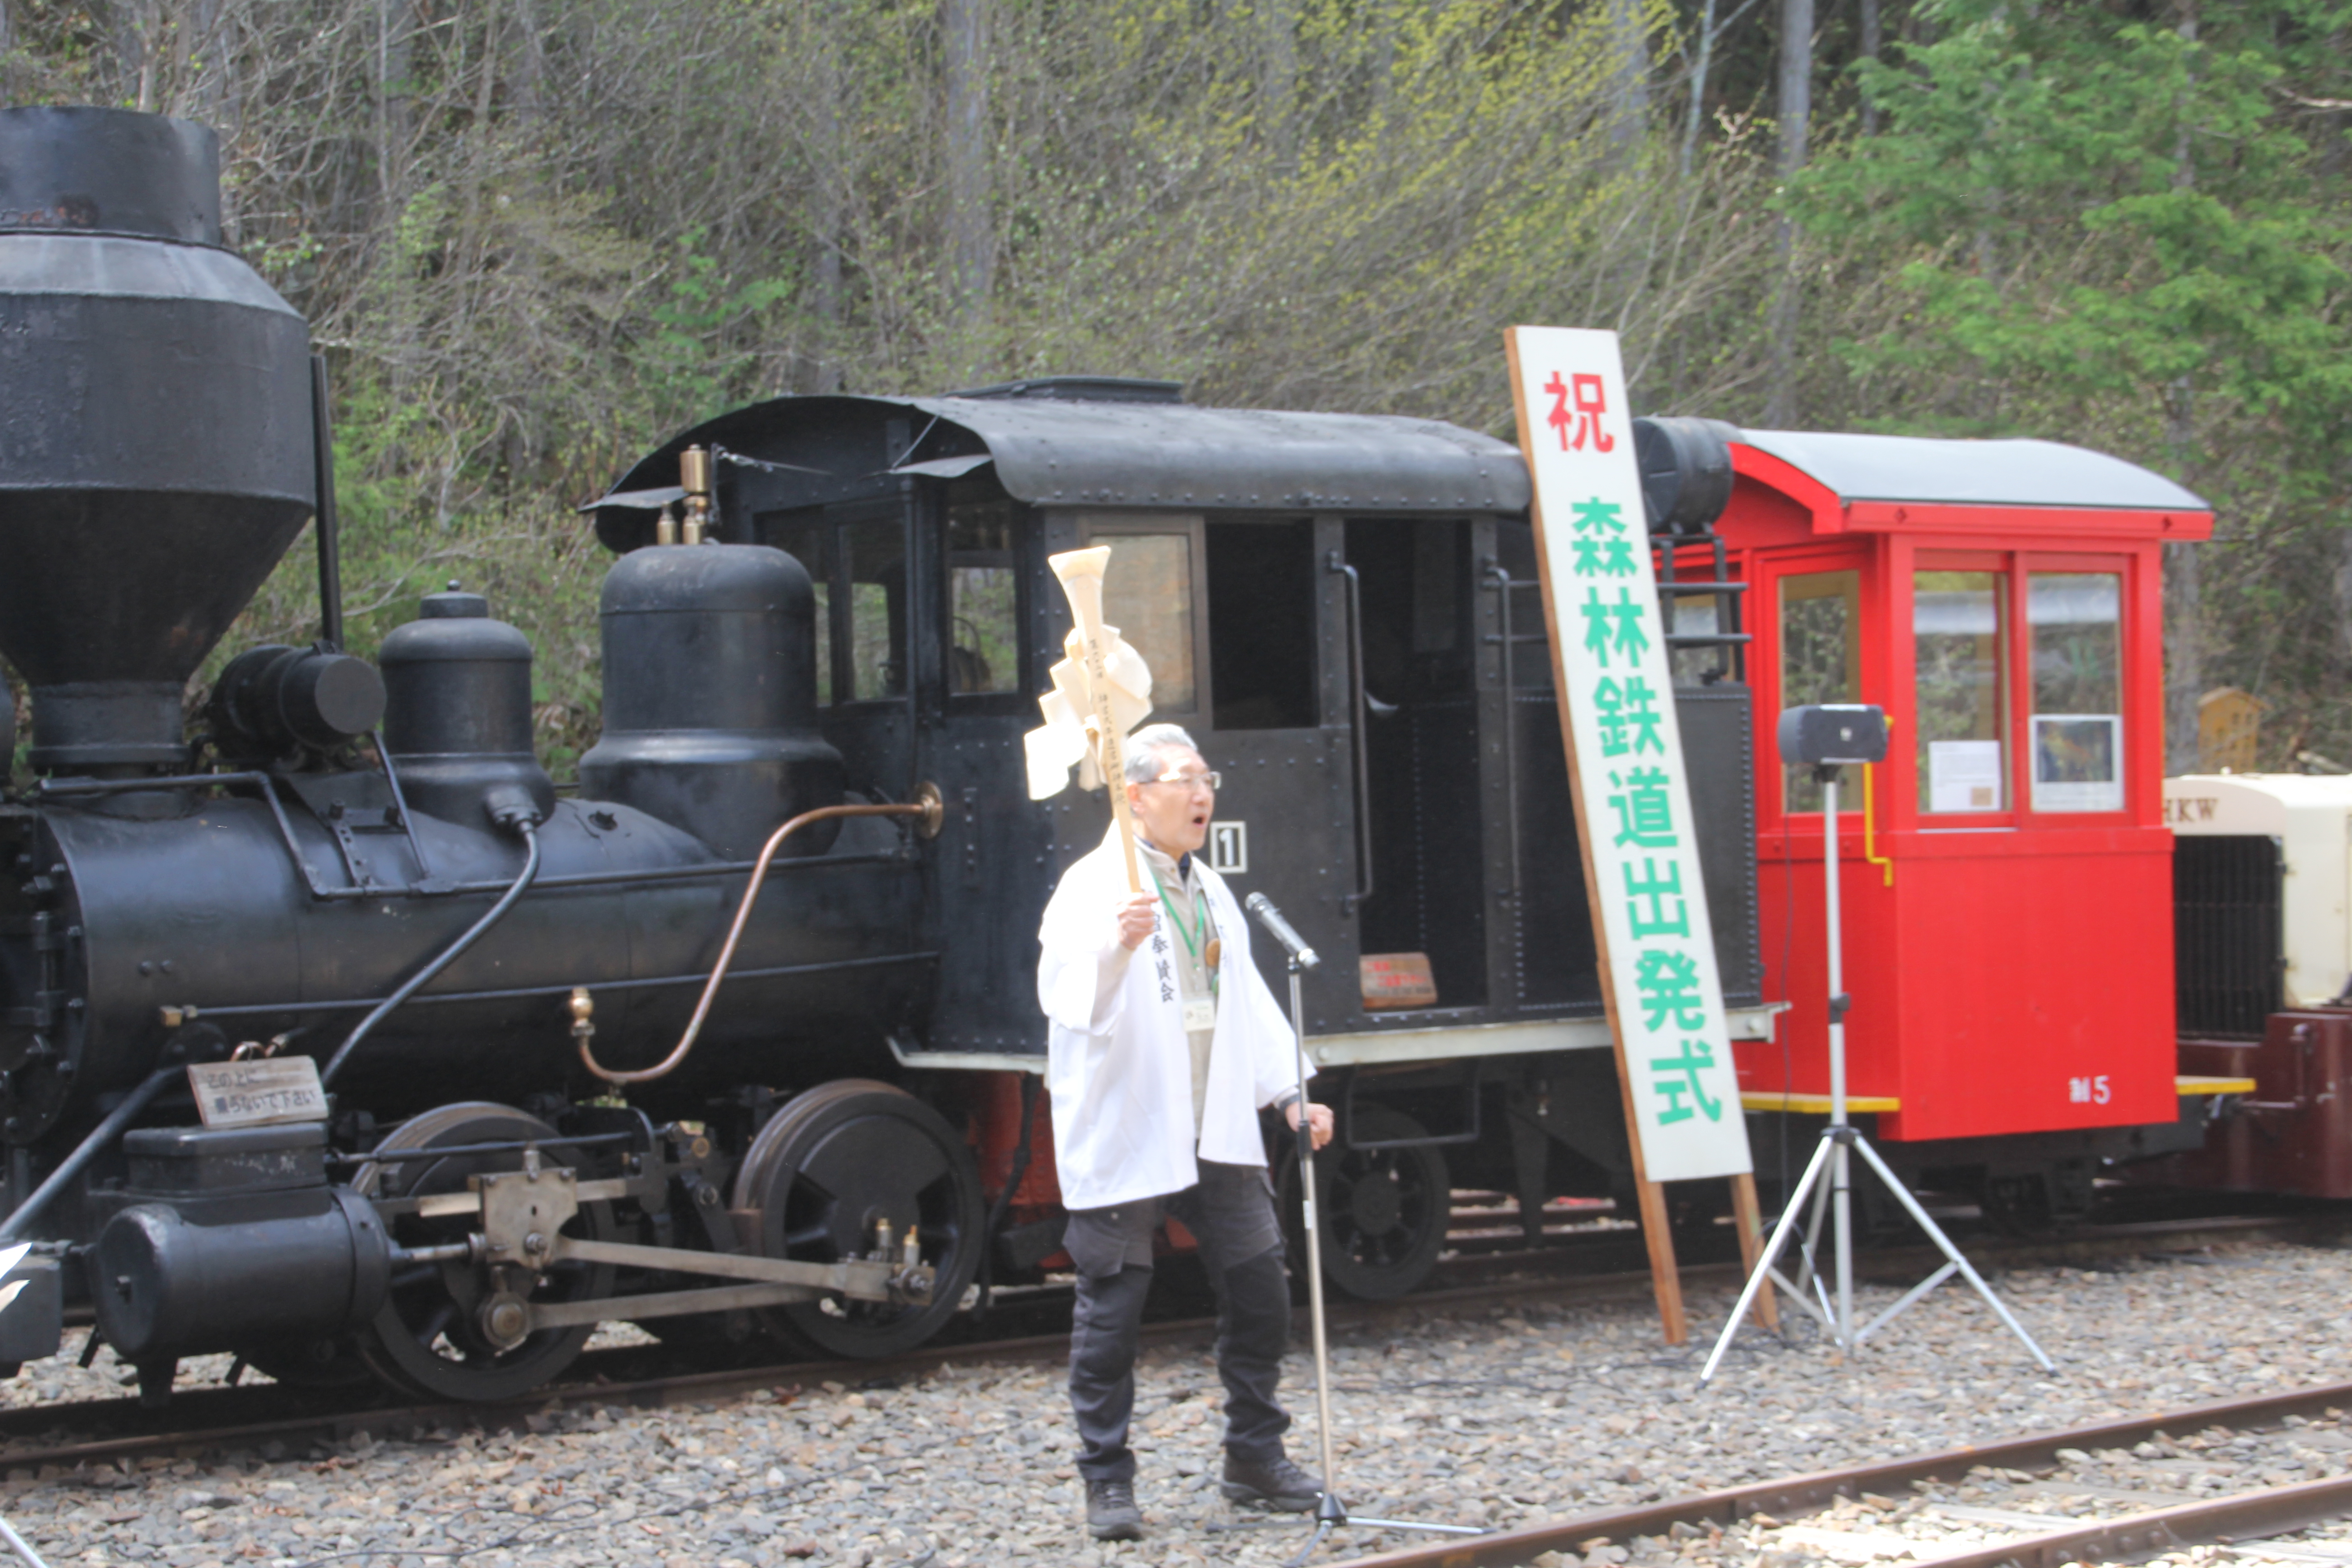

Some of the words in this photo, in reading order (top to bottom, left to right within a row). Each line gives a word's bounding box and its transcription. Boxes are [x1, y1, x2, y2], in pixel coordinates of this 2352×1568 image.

[1544, 371, 1615, 453] 祝
[1219, 828, 1234, 866] 1
[1571, 496, 1721, 1126] 森林鉄道出発式
